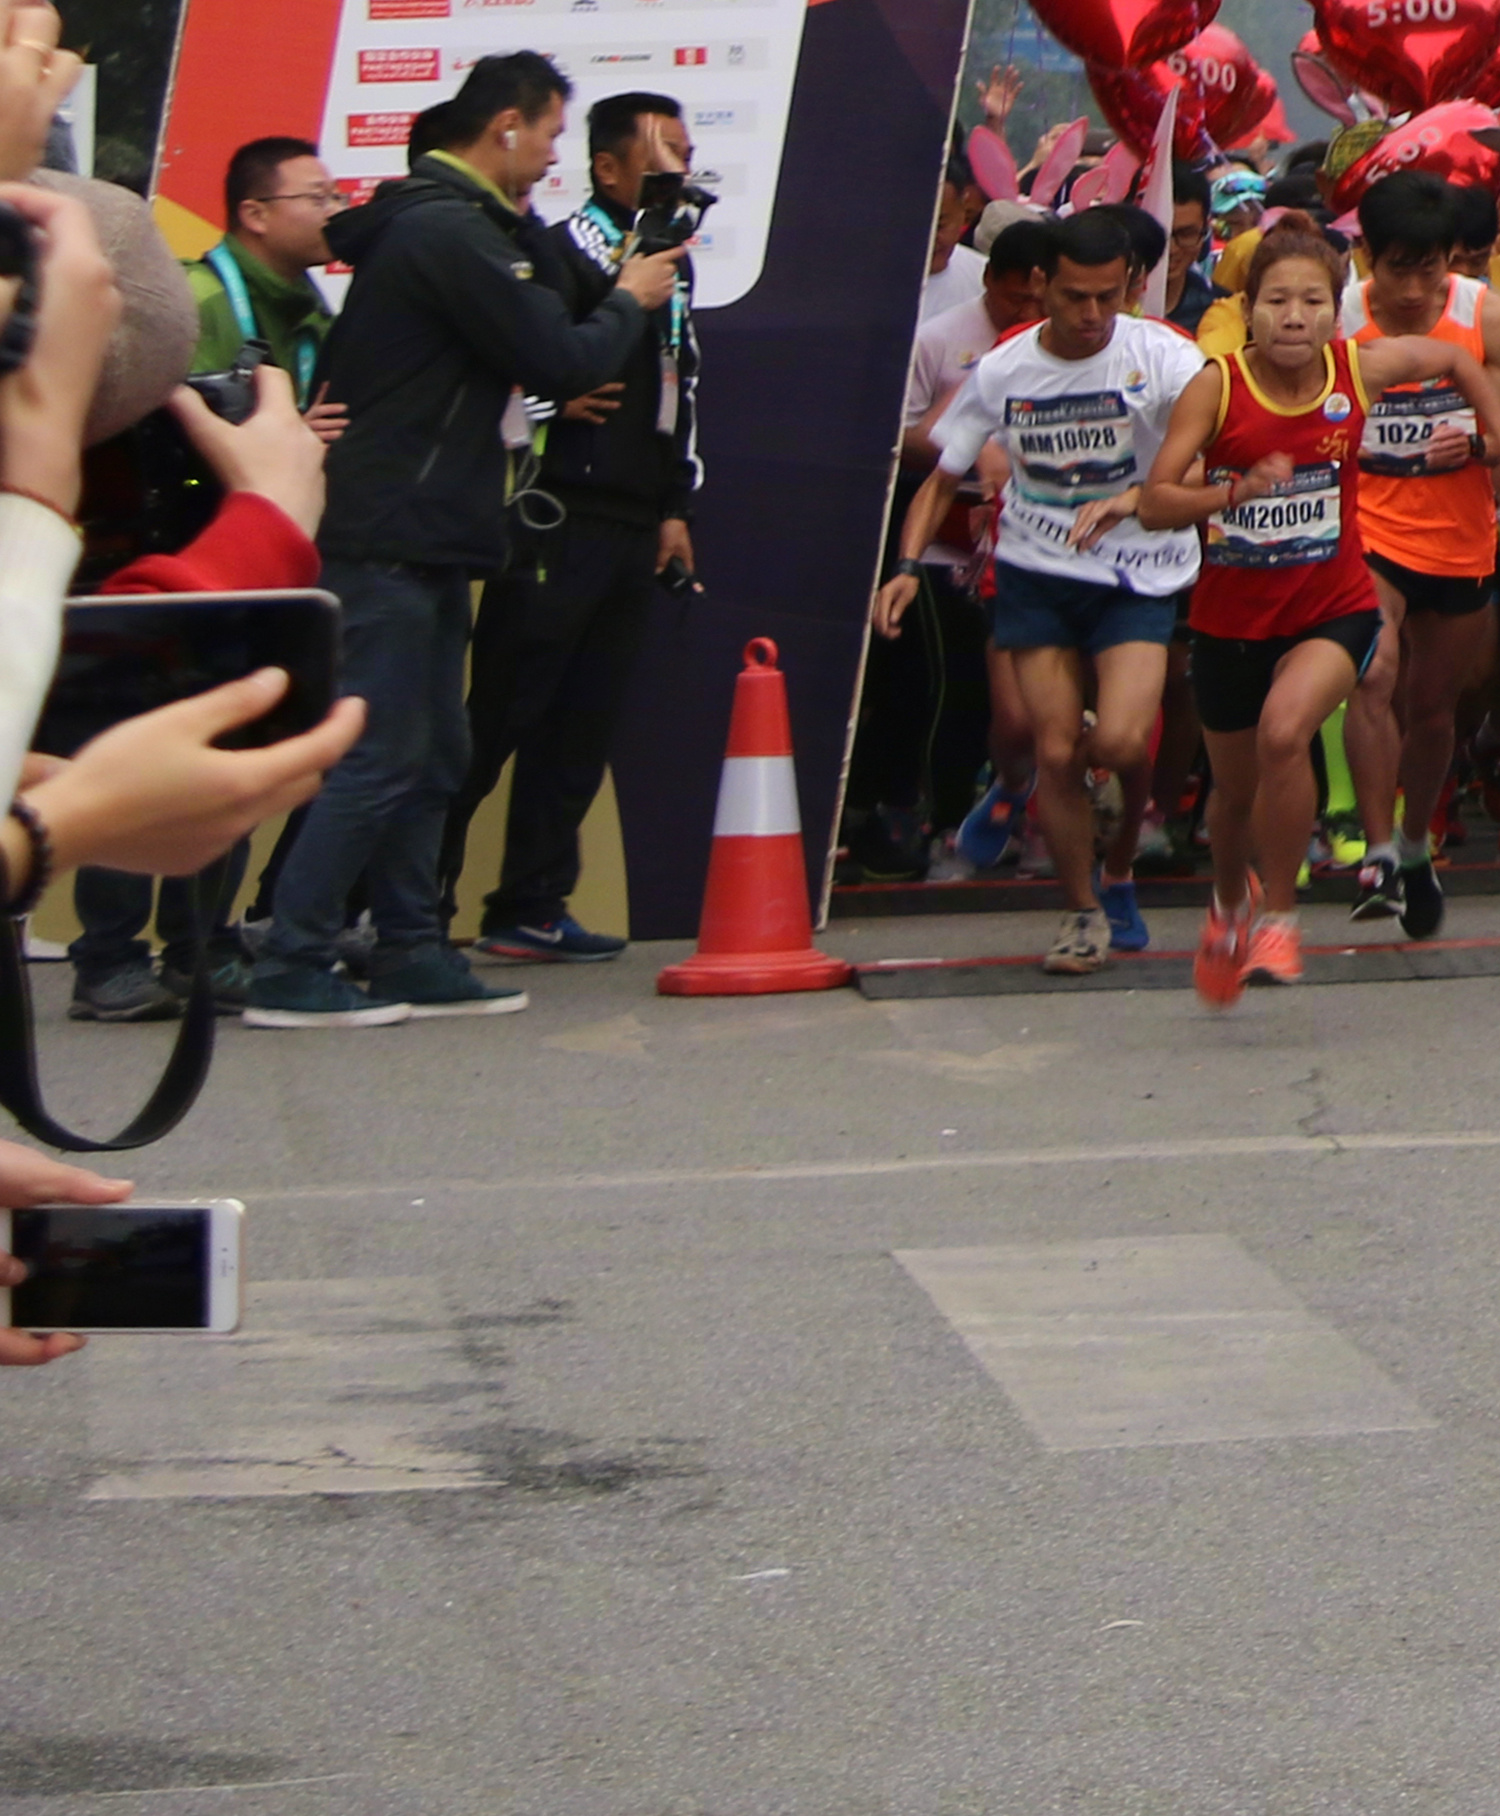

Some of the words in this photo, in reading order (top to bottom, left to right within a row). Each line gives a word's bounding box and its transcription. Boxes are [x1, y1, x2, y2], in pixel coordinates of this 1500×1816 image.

[1166, 48, 1238, 94] 6:00
[1019, 427, 1118, 455] MM10028
[1376, 418, 1452, 445] 1024
